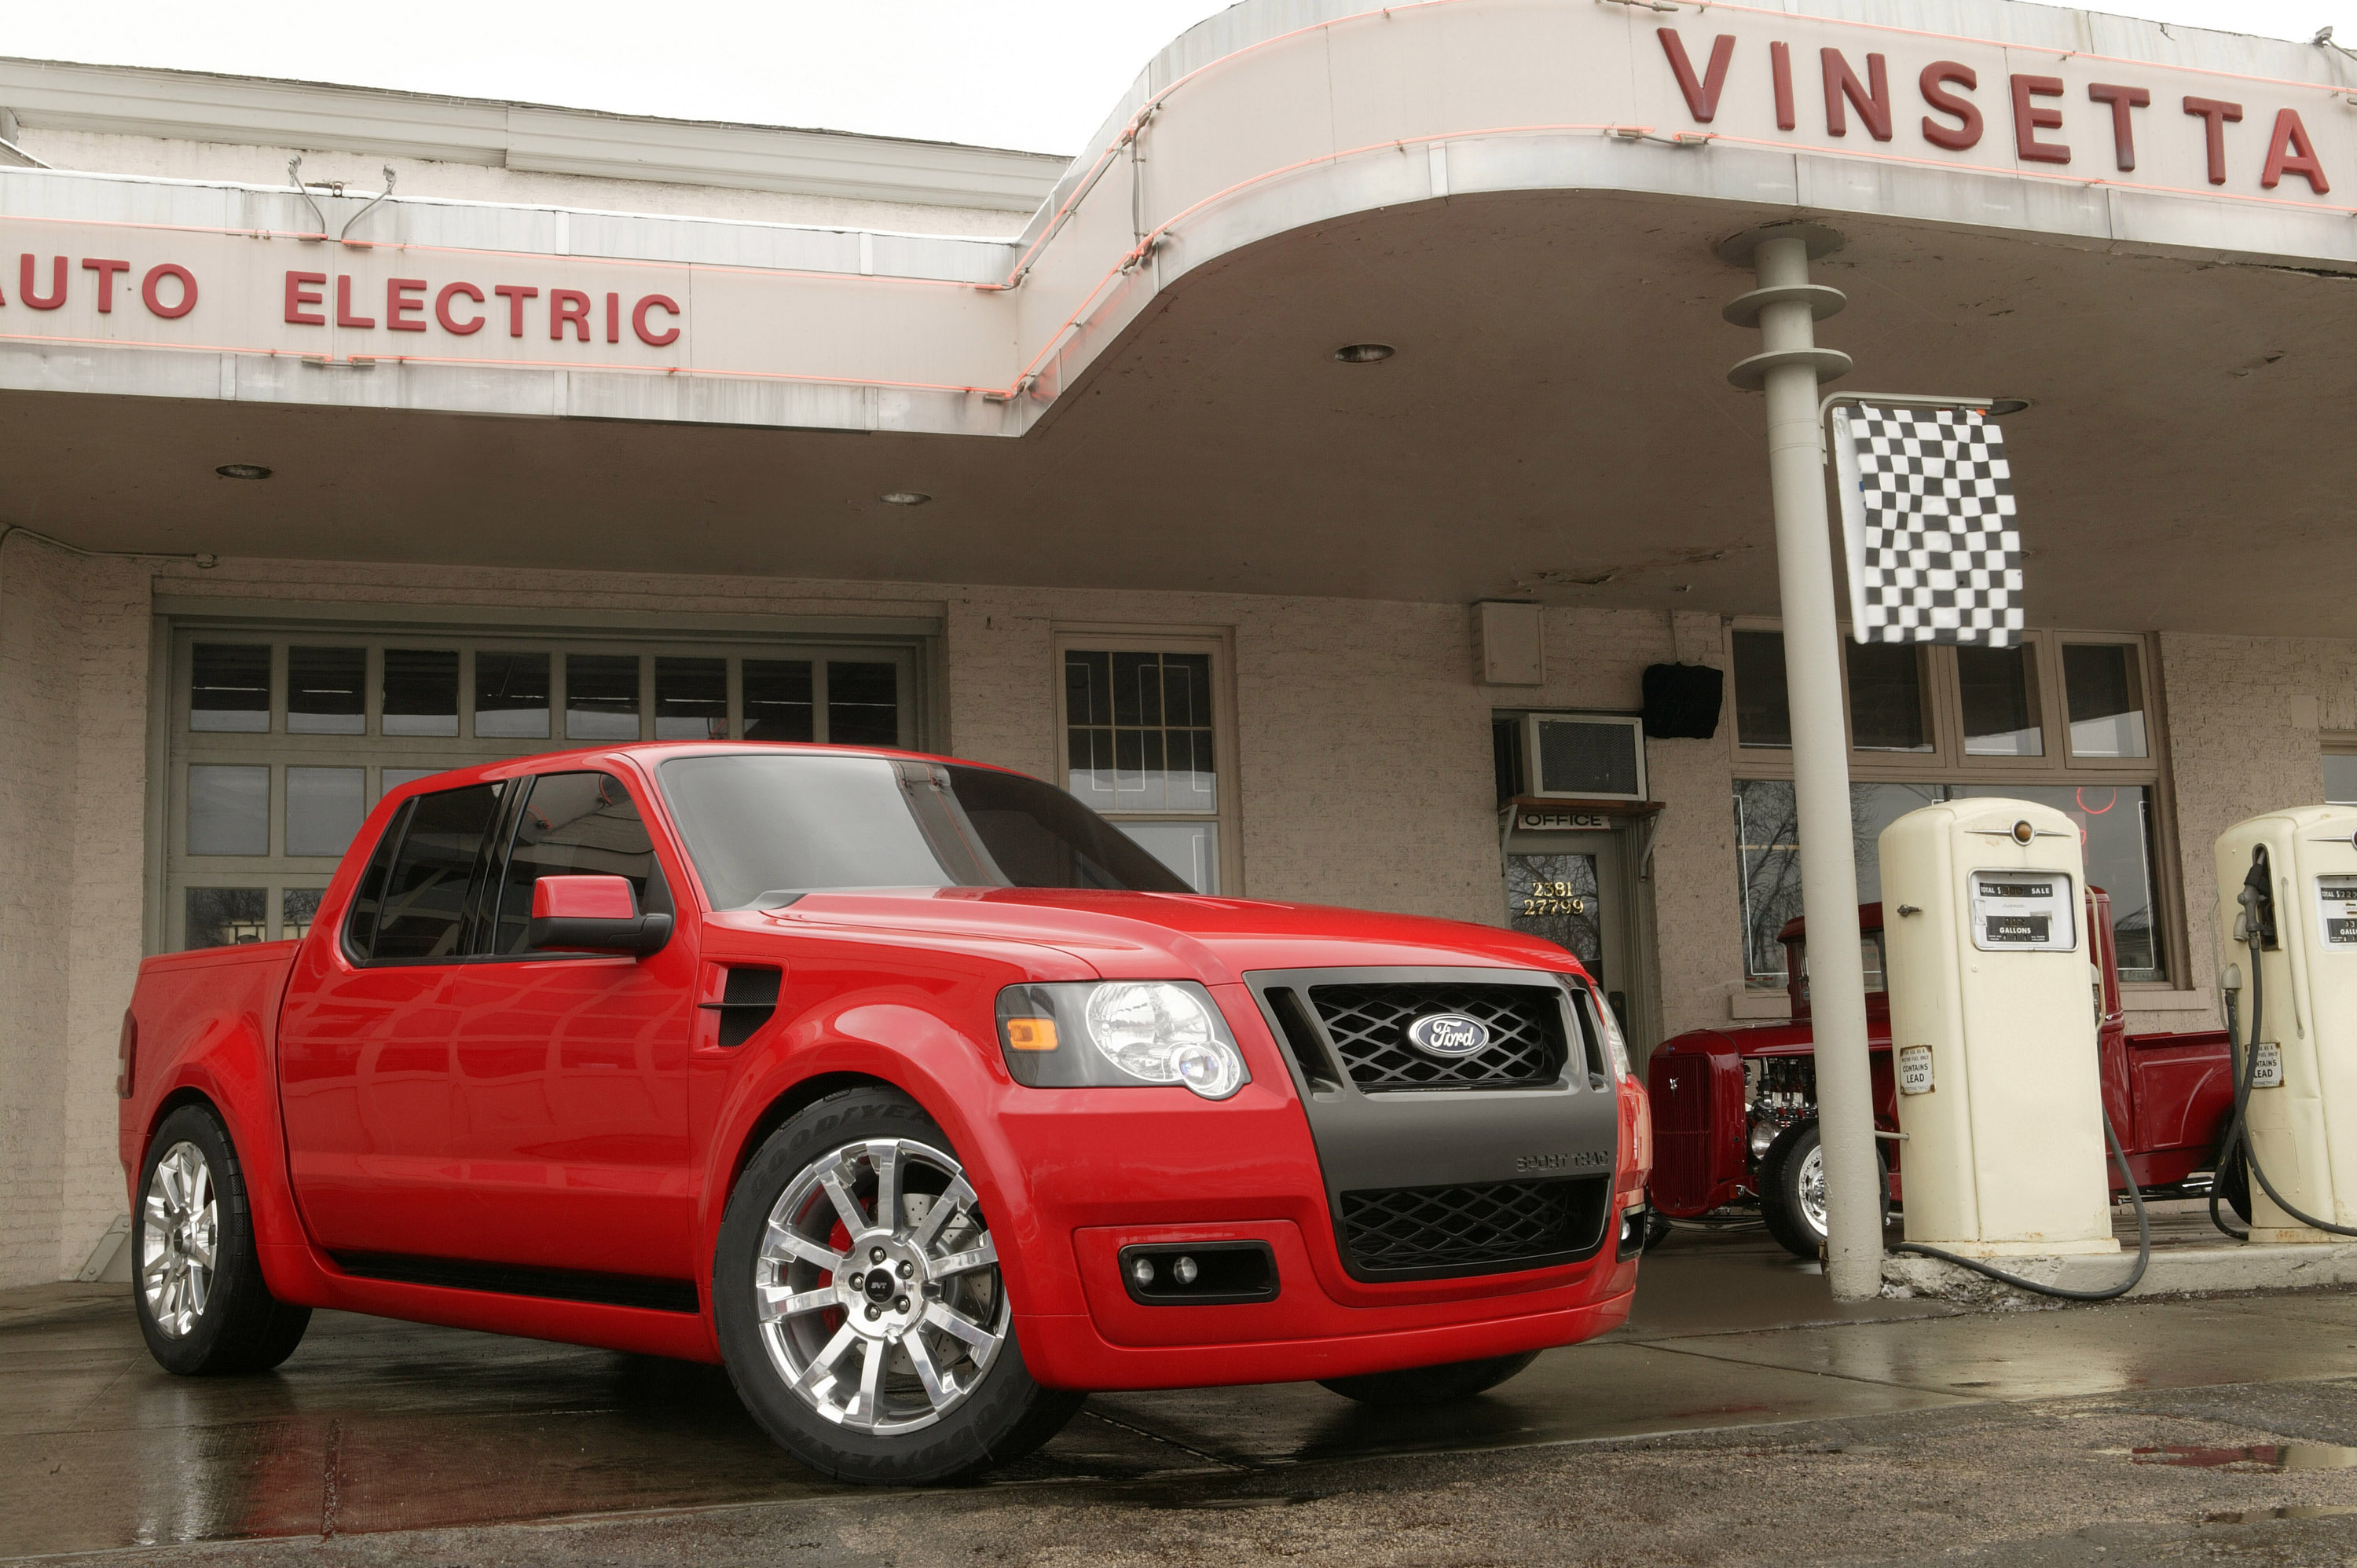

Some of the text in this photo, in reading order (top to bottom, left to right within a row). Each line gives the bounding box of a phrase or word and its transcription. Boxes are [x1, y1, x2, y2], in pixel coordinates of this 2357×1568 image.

[1657, 27, 2330, 195] VINSETTA
[0, 253, 681, 346] UTO ELECTRIC
[1525, 815, 1602, 826] OFFICE
[1533, 881, 1573, 897] 2381
[1524, 899, 1585, 915] 27799
[1430, 1020, 1475, 1048] Ford
[1902, 1063, 1928, 1072] CONTAINS
[1906, 1073, 1925, 1083] LEAD
[751, 1104, 937, 1200] GOODYEA
[1517, 1150, 1609, 1172] SPORT TRAC
